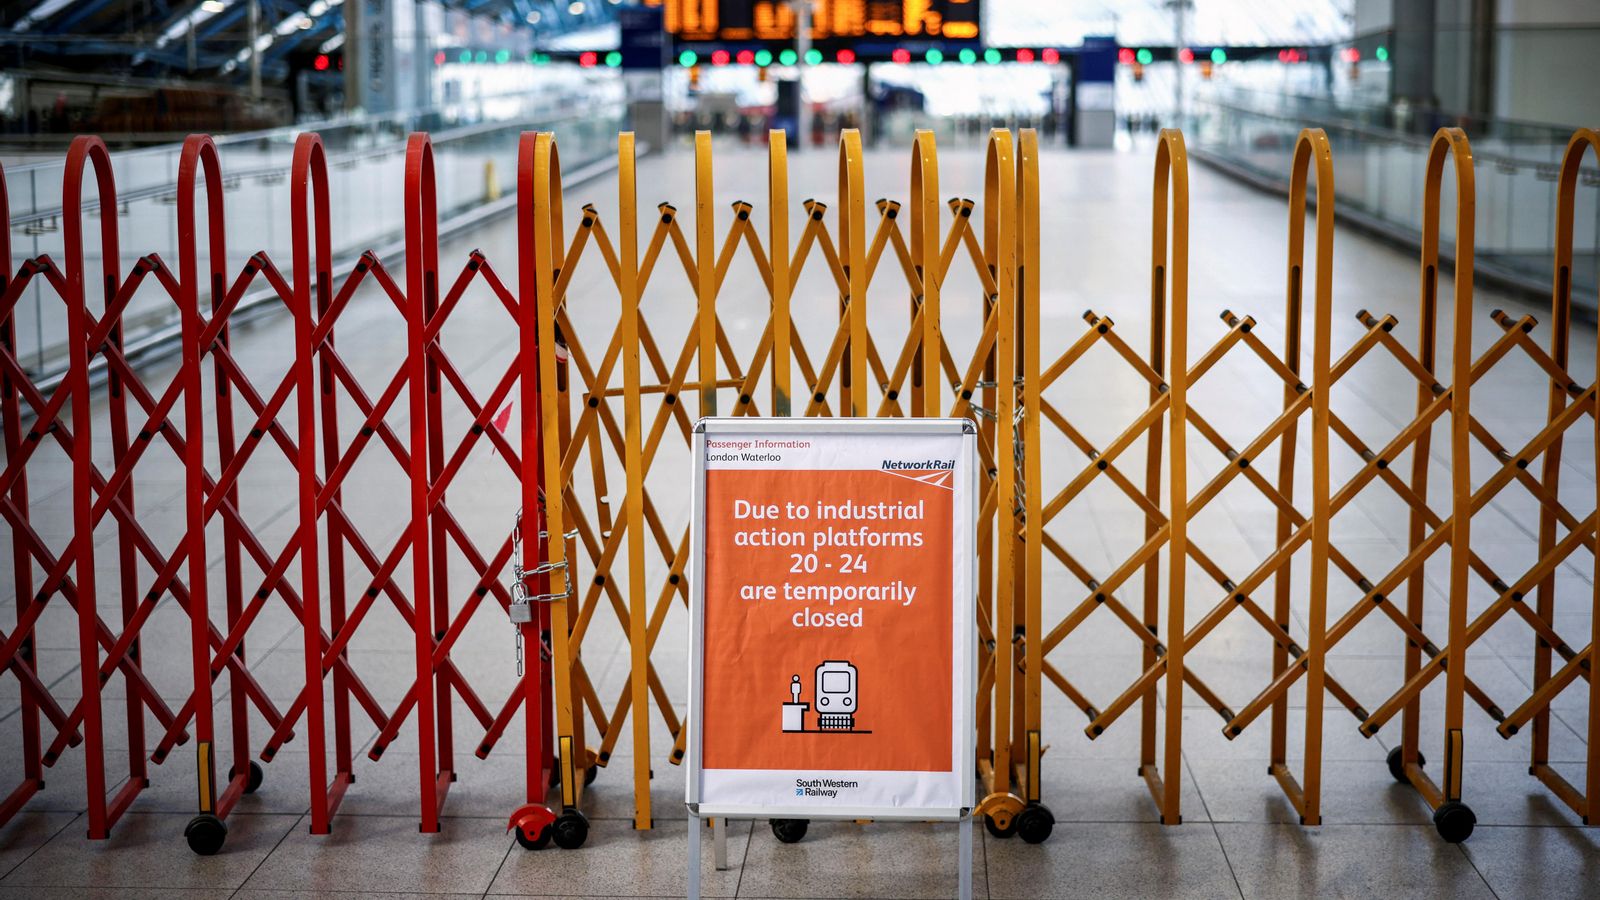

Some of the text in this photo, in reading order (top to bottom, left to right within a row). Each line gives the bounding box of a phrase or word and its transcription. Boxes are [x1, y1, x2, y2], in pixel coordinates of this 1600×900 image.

[706, 440, 811, 450] Passenger Information
[706, 453, 782, 462] London Waterloo
[735, 500, 923, 520] Due to industrial
[735, 526, 923, 551] action platforms
[790, 554, 818, 573] 20
[839, 554, 867, 573] 24
[740, 581, 916, 606] are temporarily
[792, 607, 862, 627] closed
[796, 779, 858, 788] South Western
[805, 788, 838, 798] Railway
